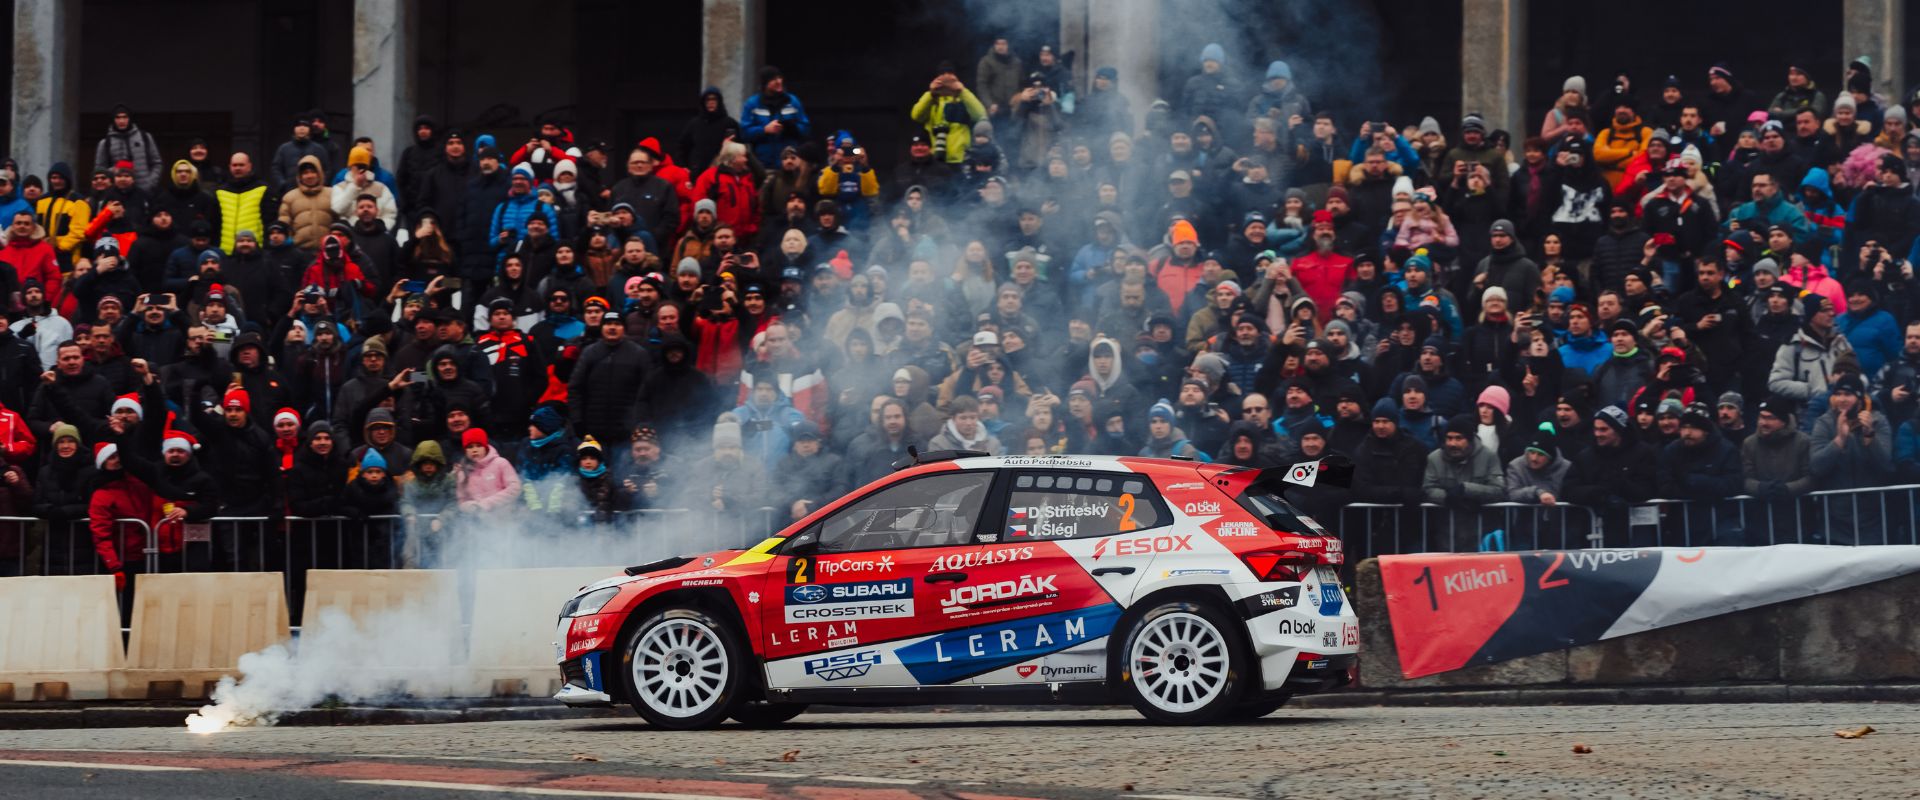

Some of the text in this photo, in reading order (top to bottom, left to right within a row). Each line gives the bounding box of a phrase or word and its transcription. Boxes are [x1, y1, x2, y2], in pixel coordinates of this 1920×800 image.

[1004, 458, 1030, 466] Auto
[1118, 493, 1137, 531] 2
[1218, 527, 1258, 537] ON-LINE
[1116, 534, 1193, 556] ESOX
[818, 559, 874, 576] TipCars
[928, 546, 1034, 573] AQUASYS
[794, 557, 808, 584] 2
[1535, 551, 1569, 589] 2
[682, 579, 723, 587] MICHELIN
[832, 582, 906, 598] SUBARU
[1414, 566, 1438, 611] 1
[1261, 598, 1293, 606] SYNERGY
[793, 604, 906, 619] CROSSTREK
[771, 621, 858, 645] LERAM
[1294, 619, 1316, 634] bak
[936, 617, 1086, 663] LERAM
[1041, 664, 1098, 677] Dynamic
